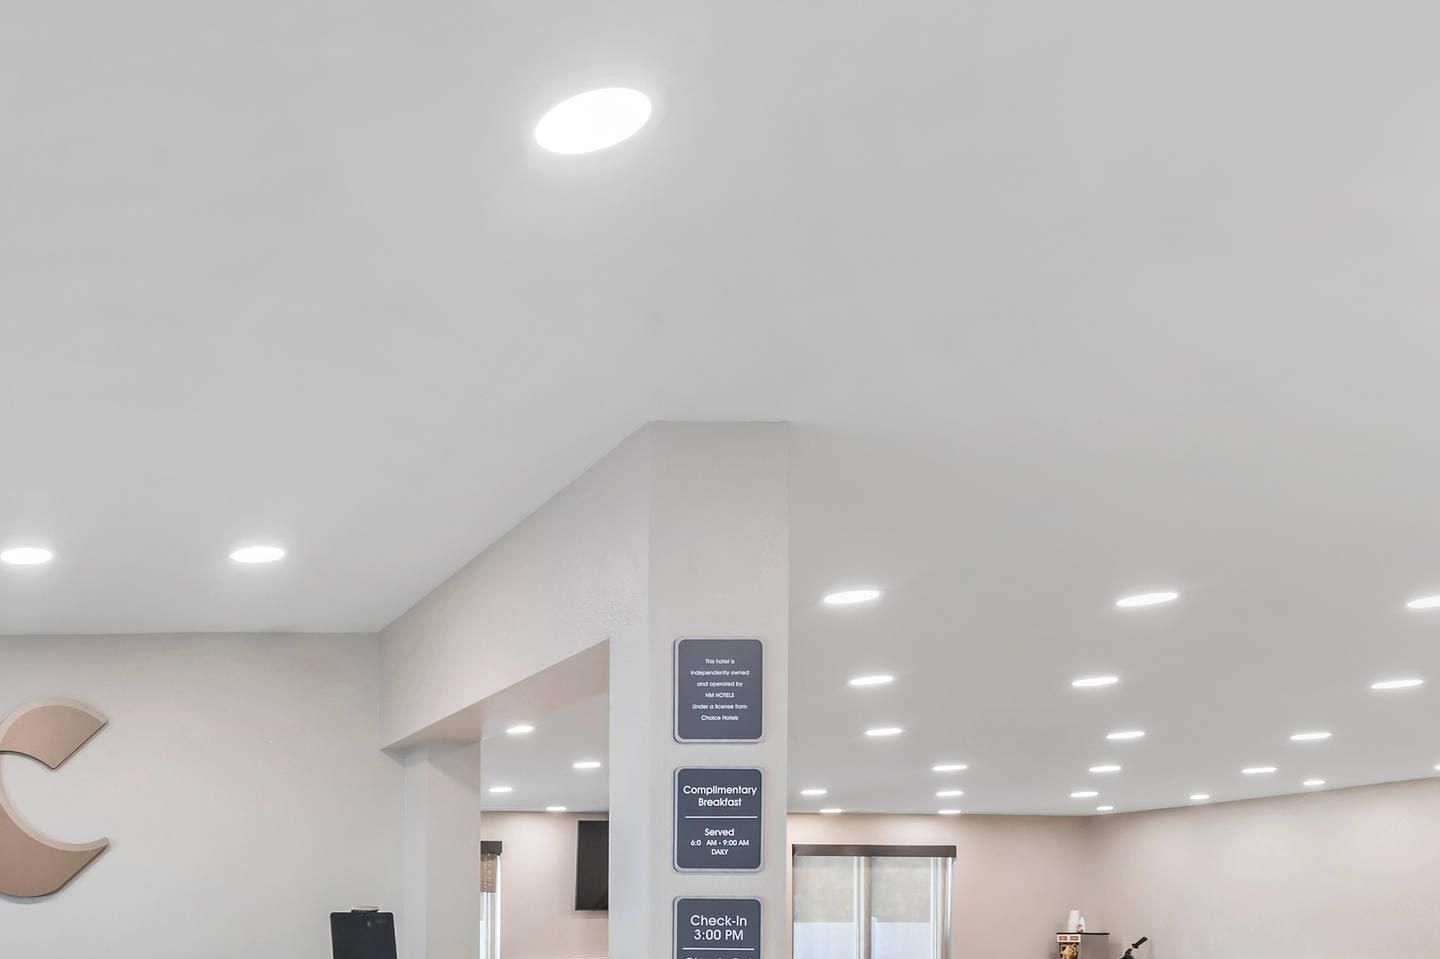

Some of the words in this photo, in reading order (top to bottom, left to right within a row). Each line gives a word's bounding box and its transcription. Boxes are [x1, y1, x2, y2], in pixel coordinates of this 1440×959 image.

[682, 785, 758, 797] Complimentary
[698, 797, 742, 807] Breakfast
[704, 827, 735, 837] Served
[706, 839, 718, 847] AM
[722, 839, 738, 847] 9:00
[738, 839, 750, 847] AM
[711, 848, 729, 856] DAILY
[690, 914, 748, 927] Check-In
[693, 928, 722, 941] 3:00
[724, 928, 744, 941] PM
